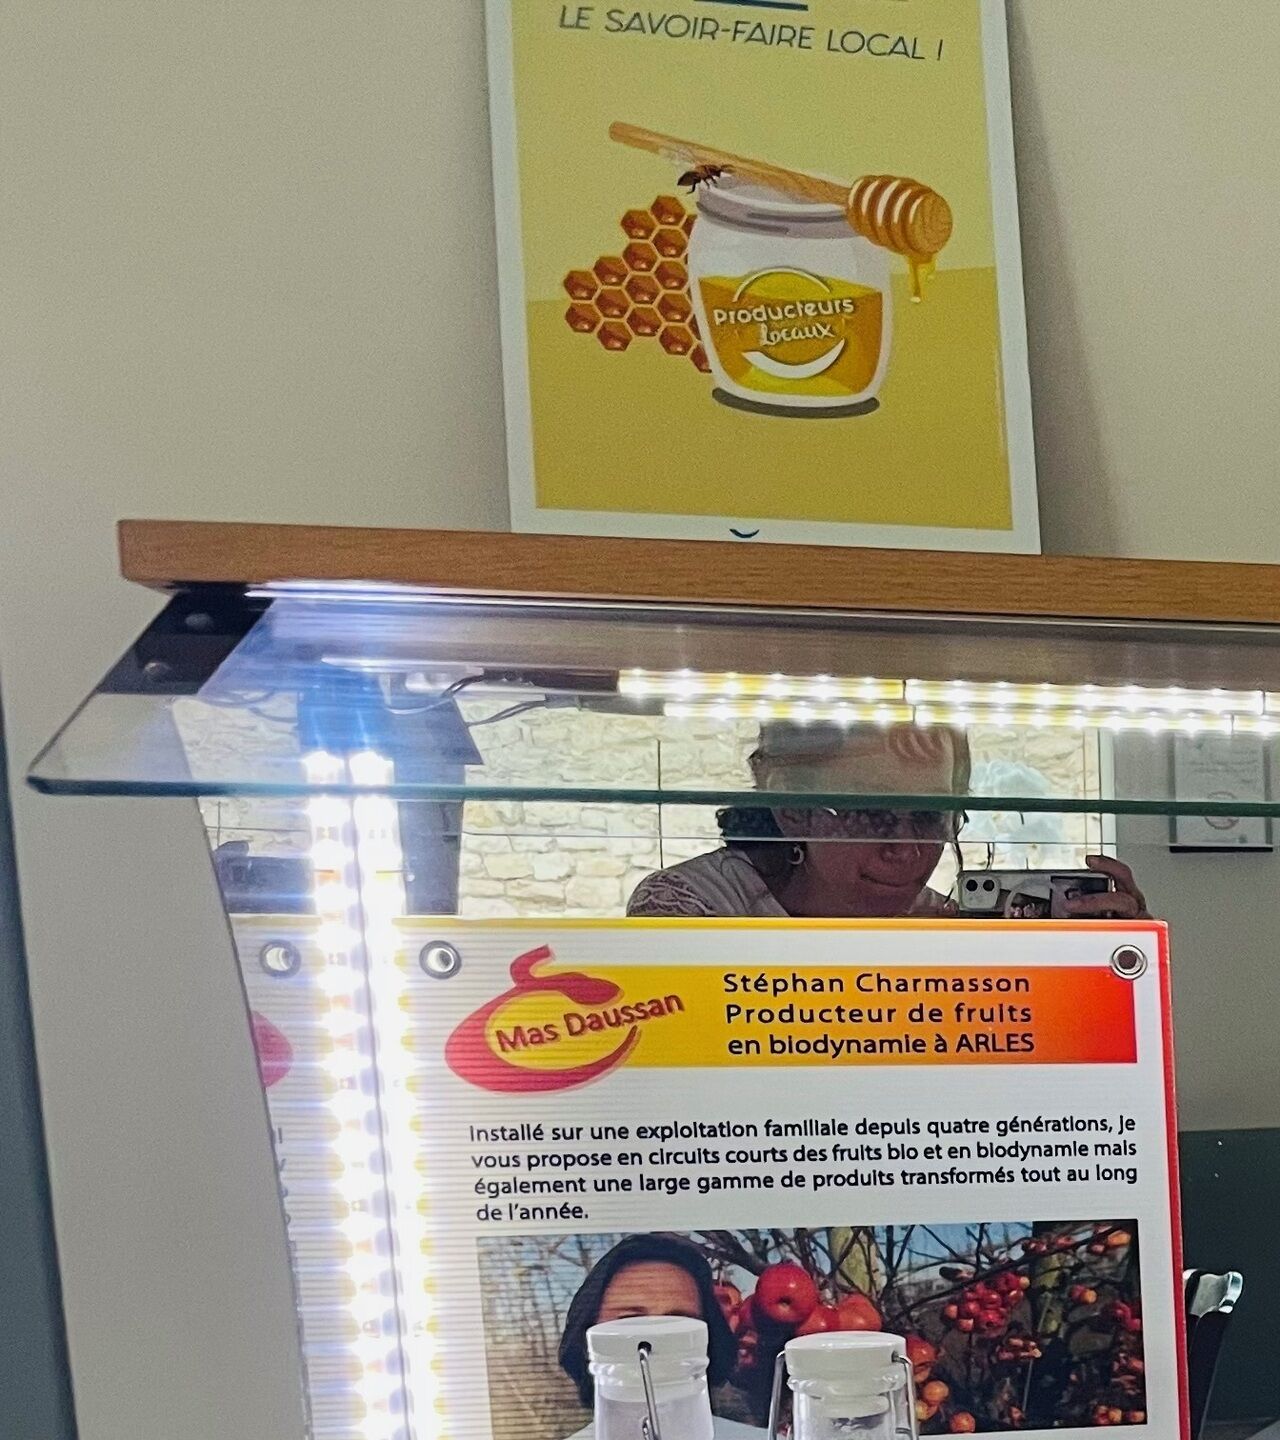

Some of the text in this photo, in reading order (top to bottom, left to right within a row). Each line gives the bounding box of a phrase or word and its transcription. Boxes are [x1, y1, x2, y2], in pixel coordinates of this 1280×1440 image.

[559, 4, 926, 60] LE SAVOIR-FAIRE LOCAL
[713, 298, 855, 327] Producteurs
[723, 971, 1031, 998] Stéphan Charmasson
[495, 993, 686, 1053] Mas Daussan
[726, 1001, 1033, 1025] Producteur de fruits
[727, 1032, 1035, 1059] en biodynamie à ARLES
[469, 1115, 1136, 1146] Installé sur une exploitation familiale depuis quatre générations, je
[471, 1139, 1137, 1172] vous propose en circuits courts des fruits bio et en biodynamie mais
[474, 1163, 1138, 1198] également une large gamme de produits transformés tout au long
[476, 1203, 503, 1221] de
